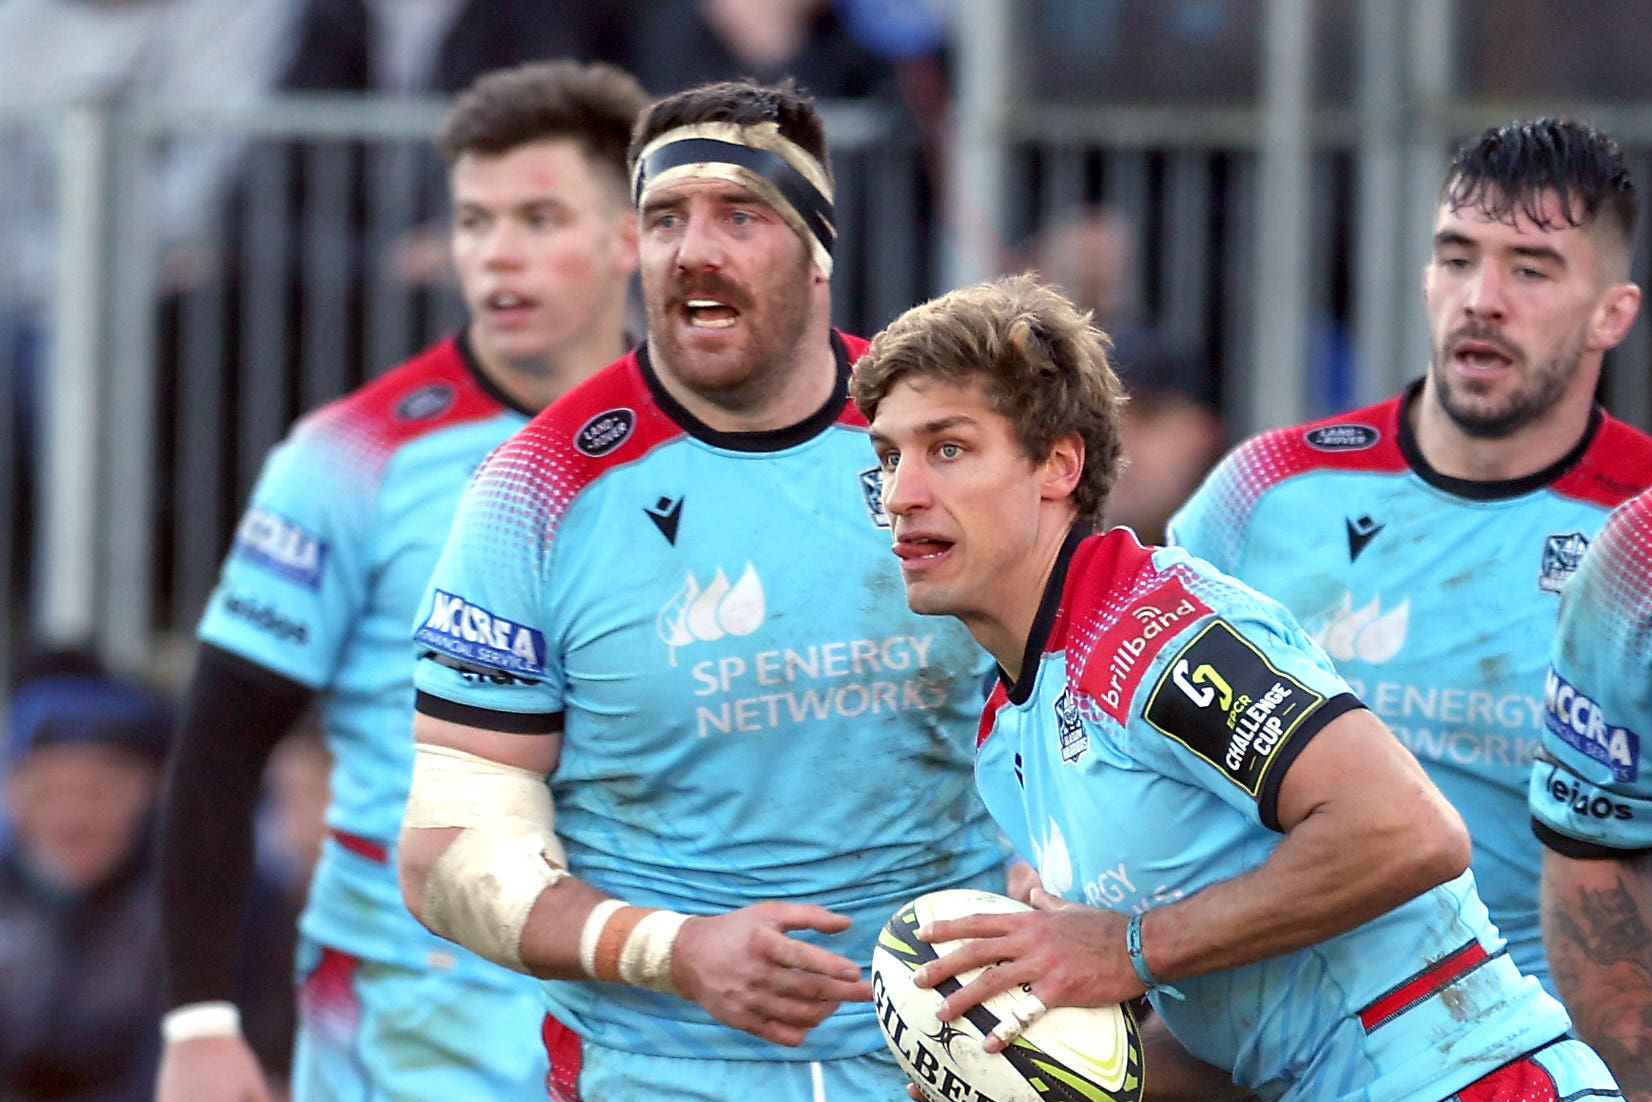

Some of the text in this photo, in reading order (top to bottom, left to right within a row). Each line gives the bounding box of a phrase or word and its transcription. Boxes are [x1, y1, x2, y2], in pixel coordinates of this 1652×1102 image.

[583, 418, 614, 440] LAND
[426, 591, 538, 665] MCCREA
[1101, 599, 1195, 709] brillband
[692, 634, 933, 697] SP ENERGY
[696, 678, 951, 739] NETWORKS
[1226, 694, 1252, 730] EPCR
[1226, 682, 1292, 771] CHALLENGE
[1254, 716, 1284, 756] CUP
[1375, 681, 1544, 731] ENERGY
